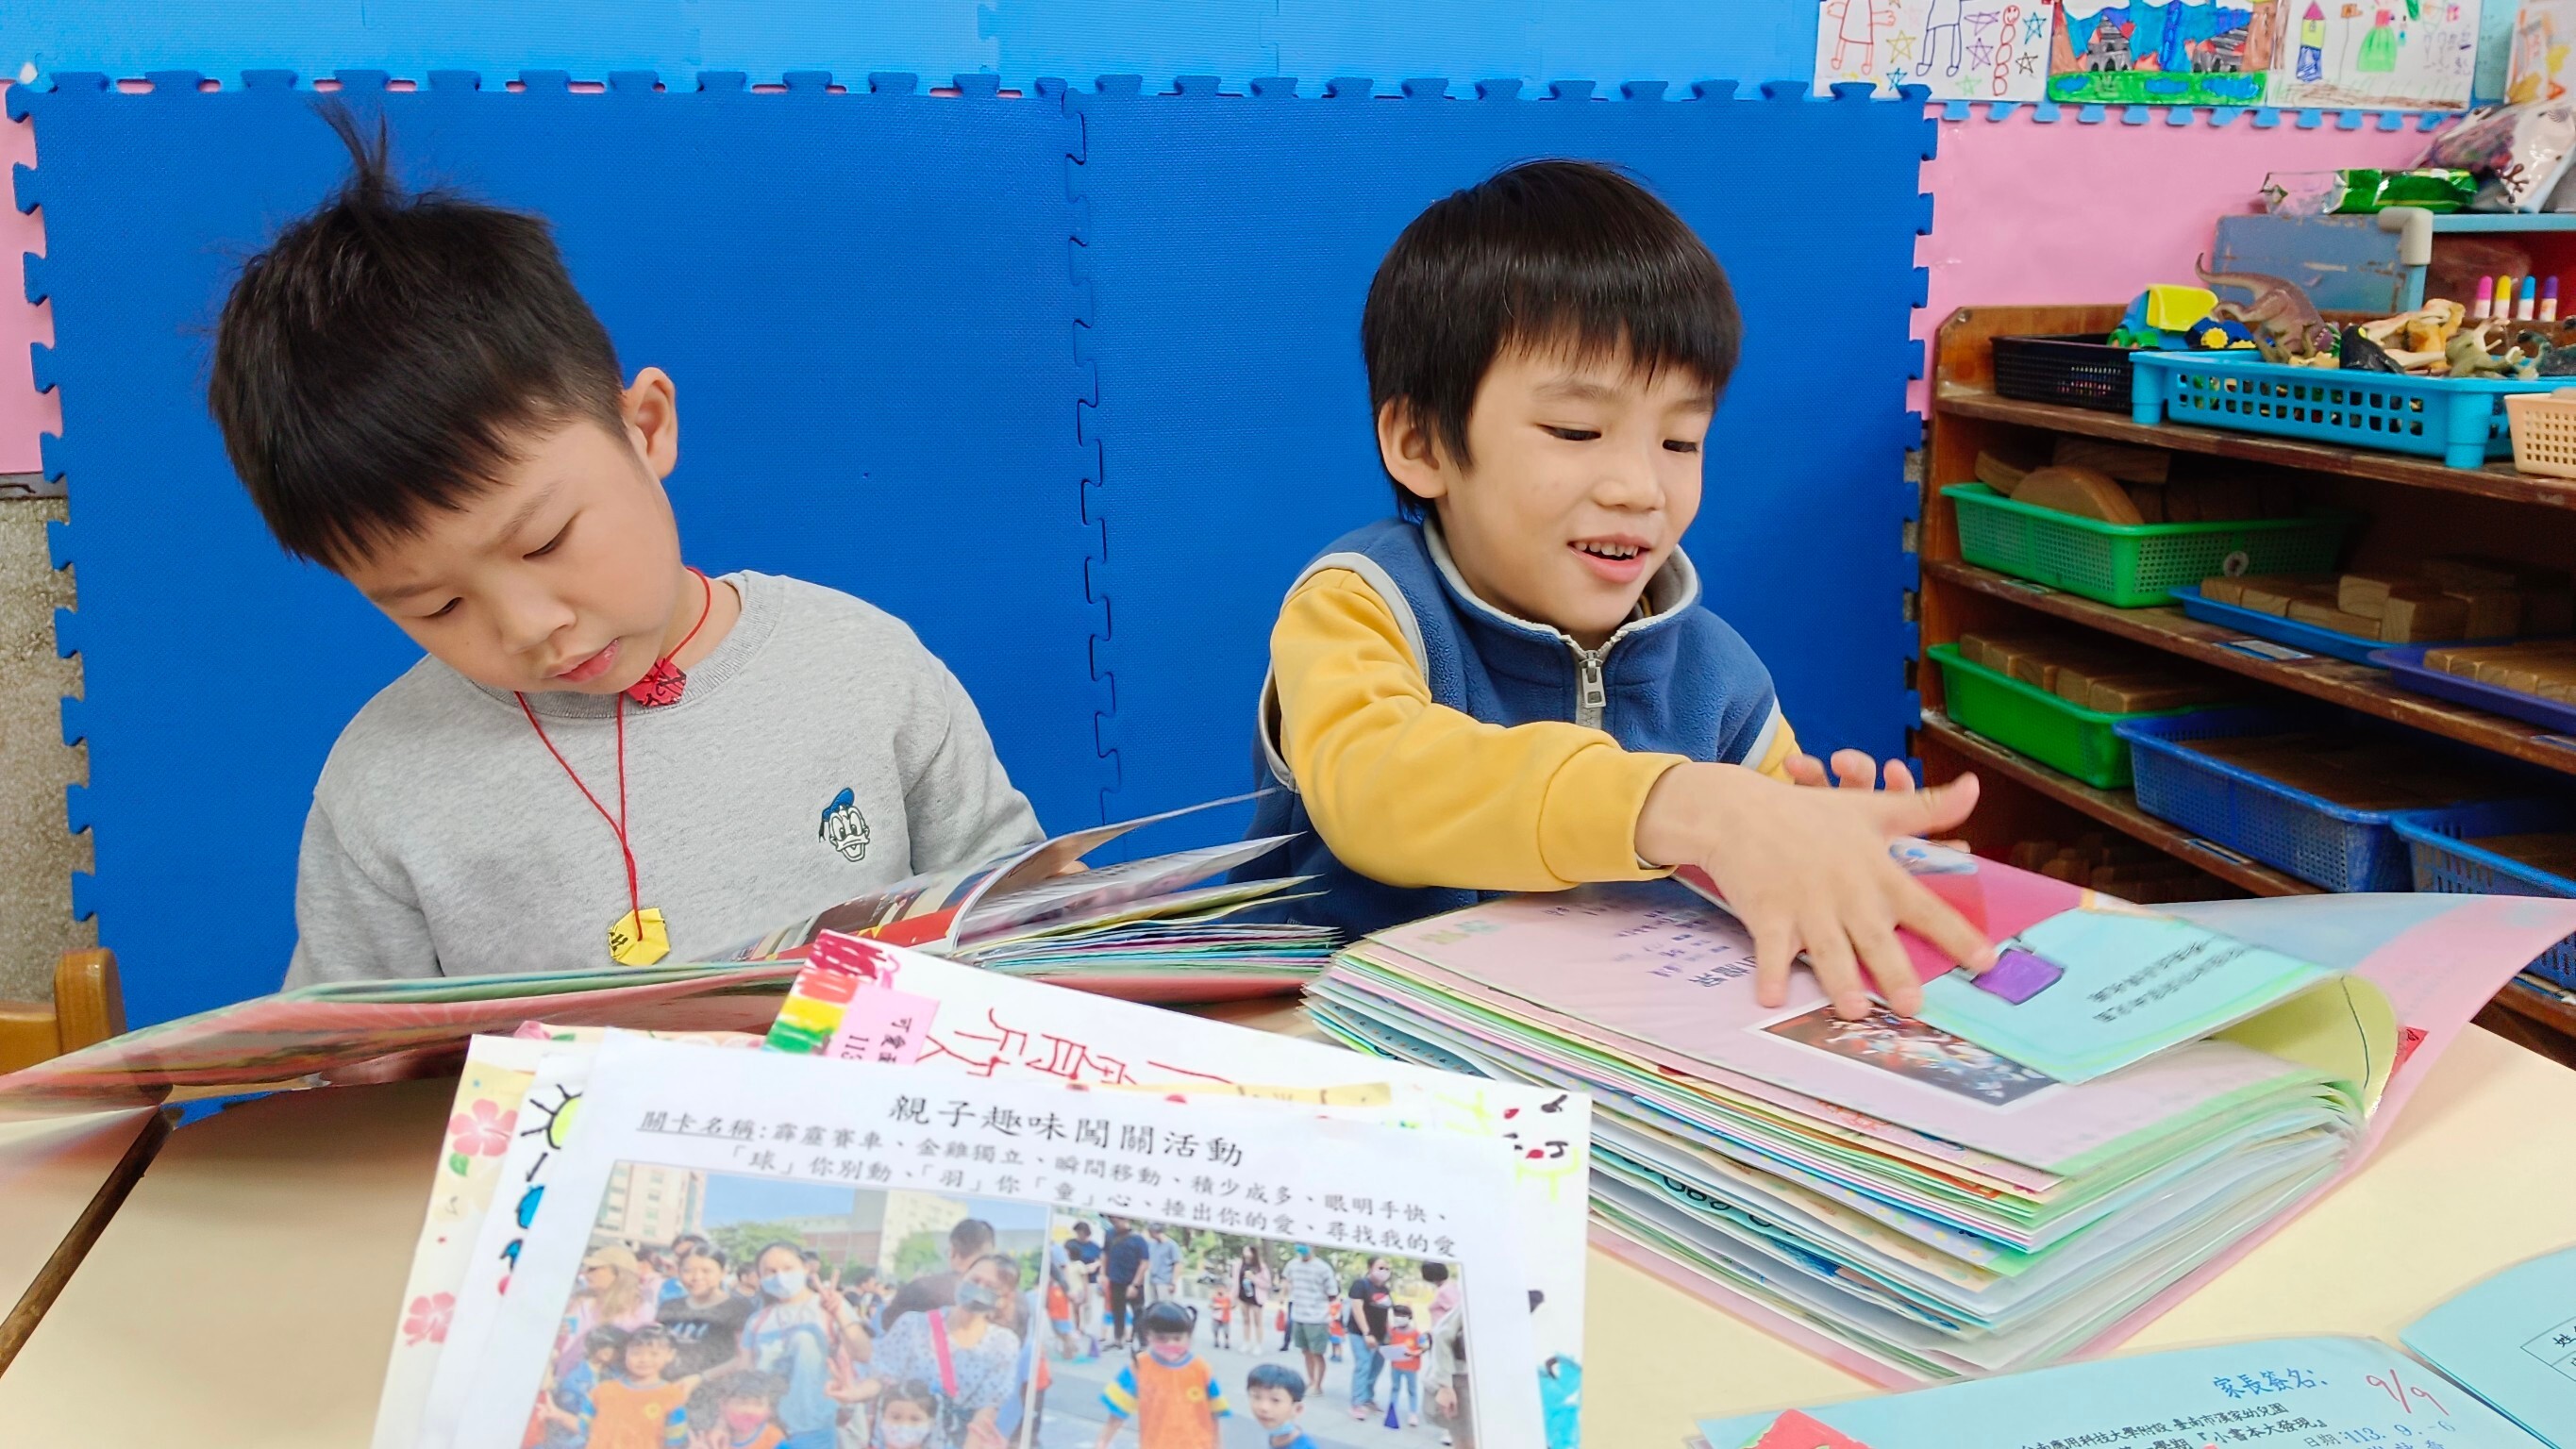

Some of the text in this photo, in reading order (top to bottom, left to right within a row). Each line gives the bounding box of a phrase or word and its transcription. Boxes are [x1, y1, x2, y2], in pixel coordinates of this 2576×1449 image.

[888, 1094, 1244, 1167] 親子趣味闖關活動
[2366, 1368, 2450, 1417] 9/9
